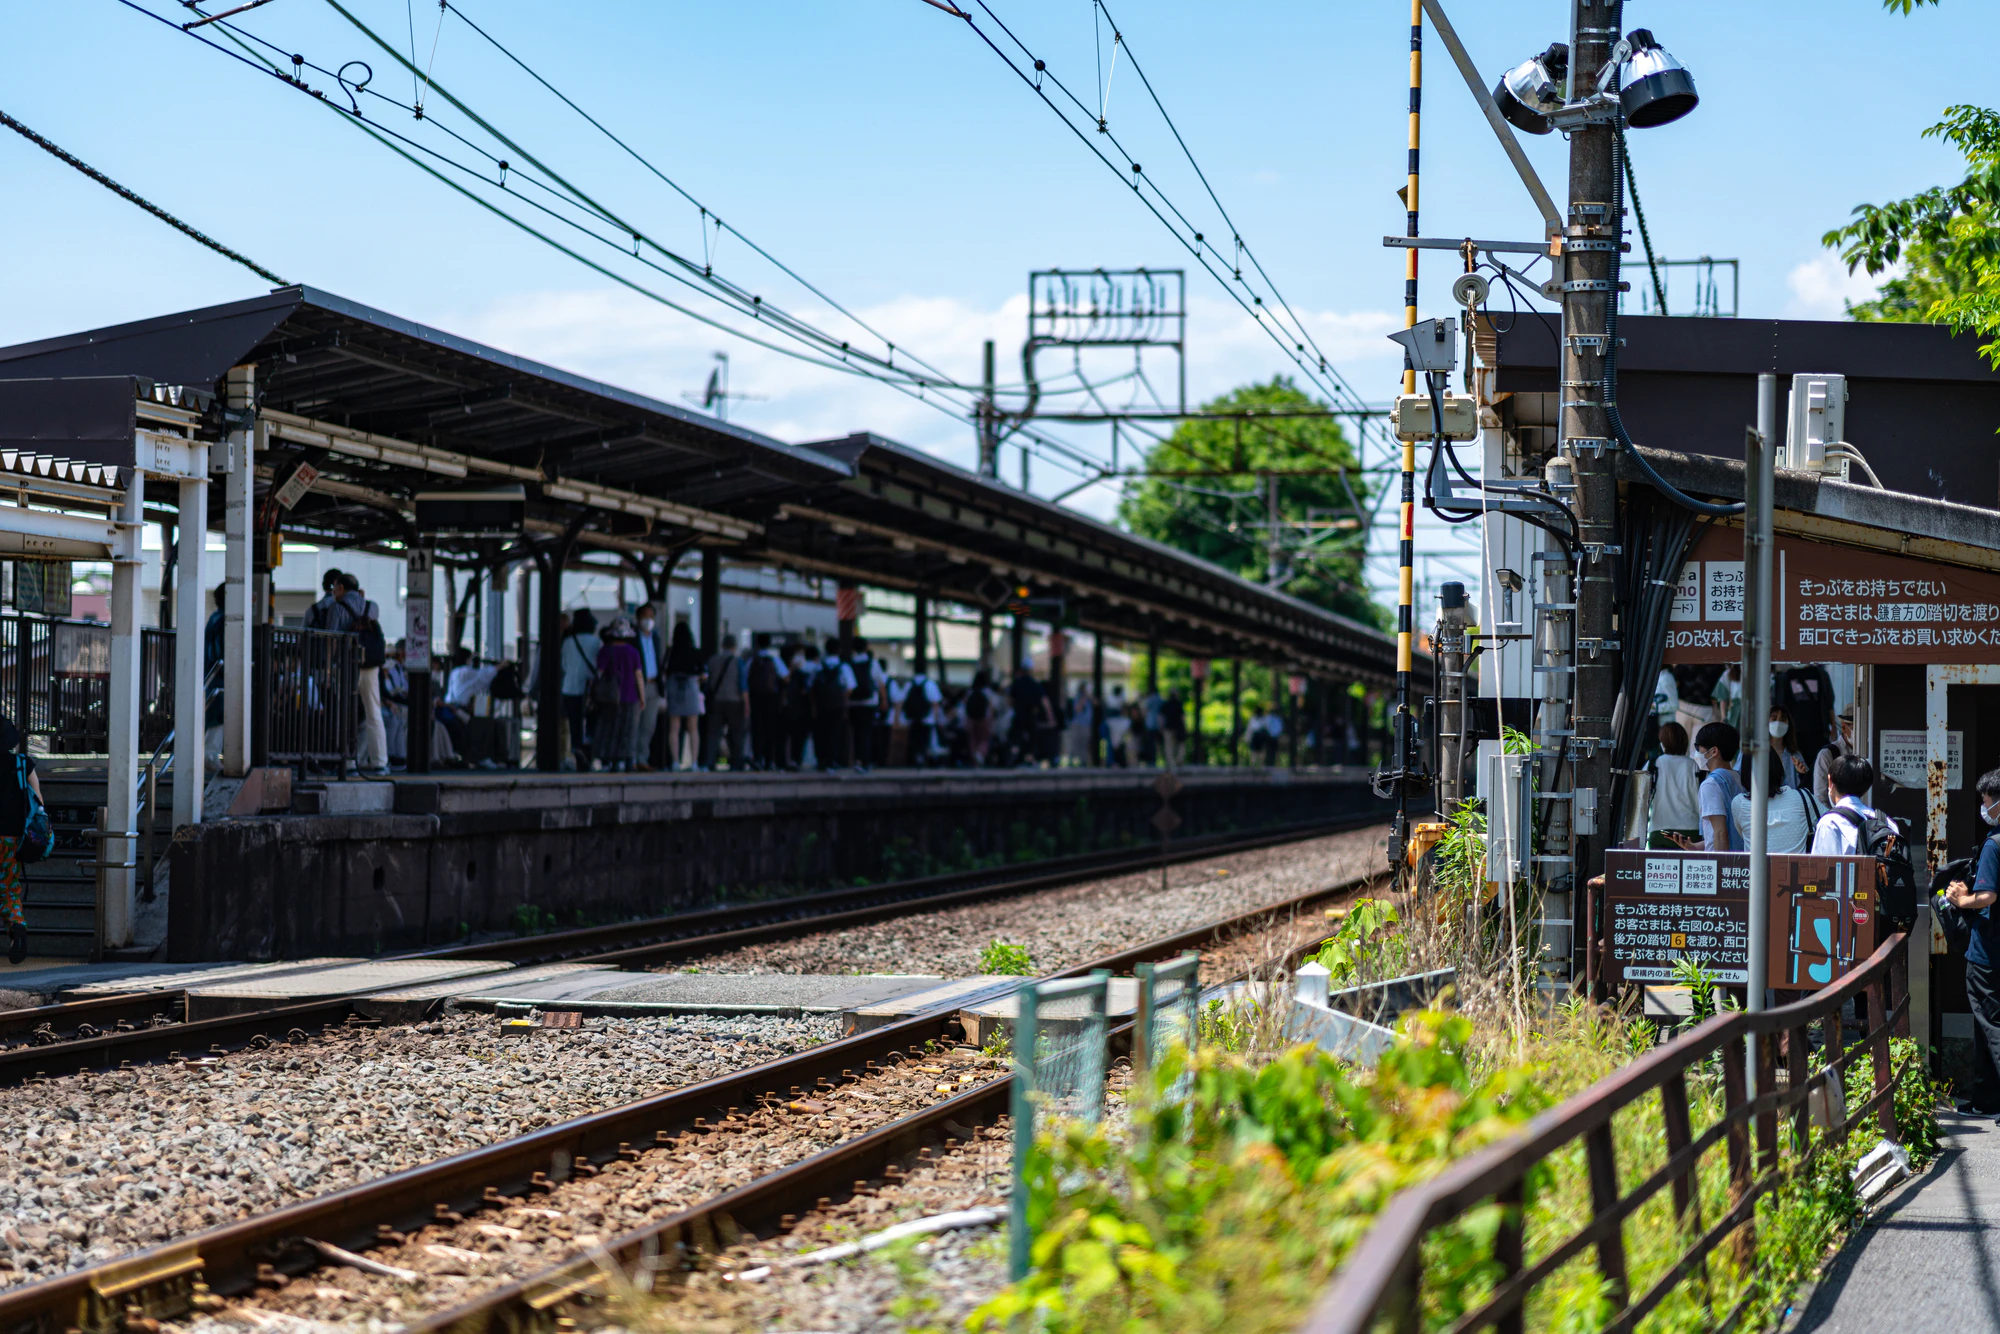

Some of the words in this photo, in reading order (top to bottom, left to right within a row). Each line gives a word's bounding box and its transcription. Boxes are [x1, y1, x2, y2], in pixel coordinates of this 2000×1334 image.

[1799, 579, 1947, 597] きっぷをお持ちでない
[1647, 863, 1679, 871] Suica
[1616, 870, 1643, 880] ここは
[1647, 872, 1678, 880] PASMO
[1614, 903, 1730, 917] きっぷをお持ちでない
[1614, 918, 1746, 933] お客さまは、右図のように
